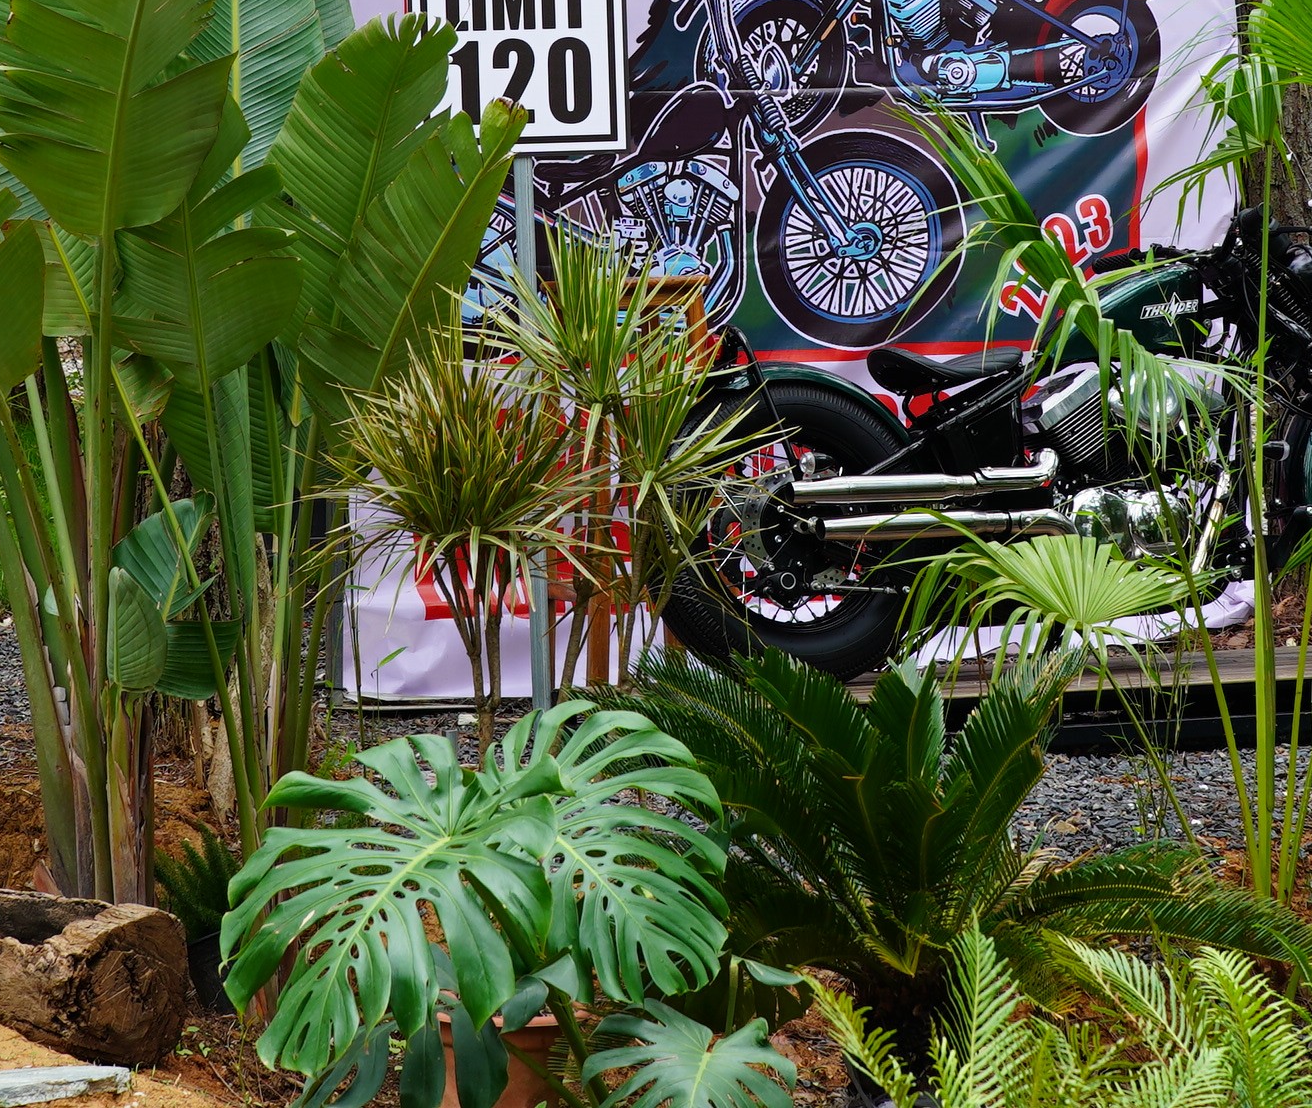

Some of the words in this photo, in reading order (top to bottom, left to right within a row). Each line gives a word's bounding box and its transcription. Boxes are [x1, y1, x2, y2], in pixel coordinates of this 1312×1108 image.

[449, 37, 593, 125] 120
[998, 193, 1114, 324] 223
[1143, 296, 1199, 320] THUNDER
